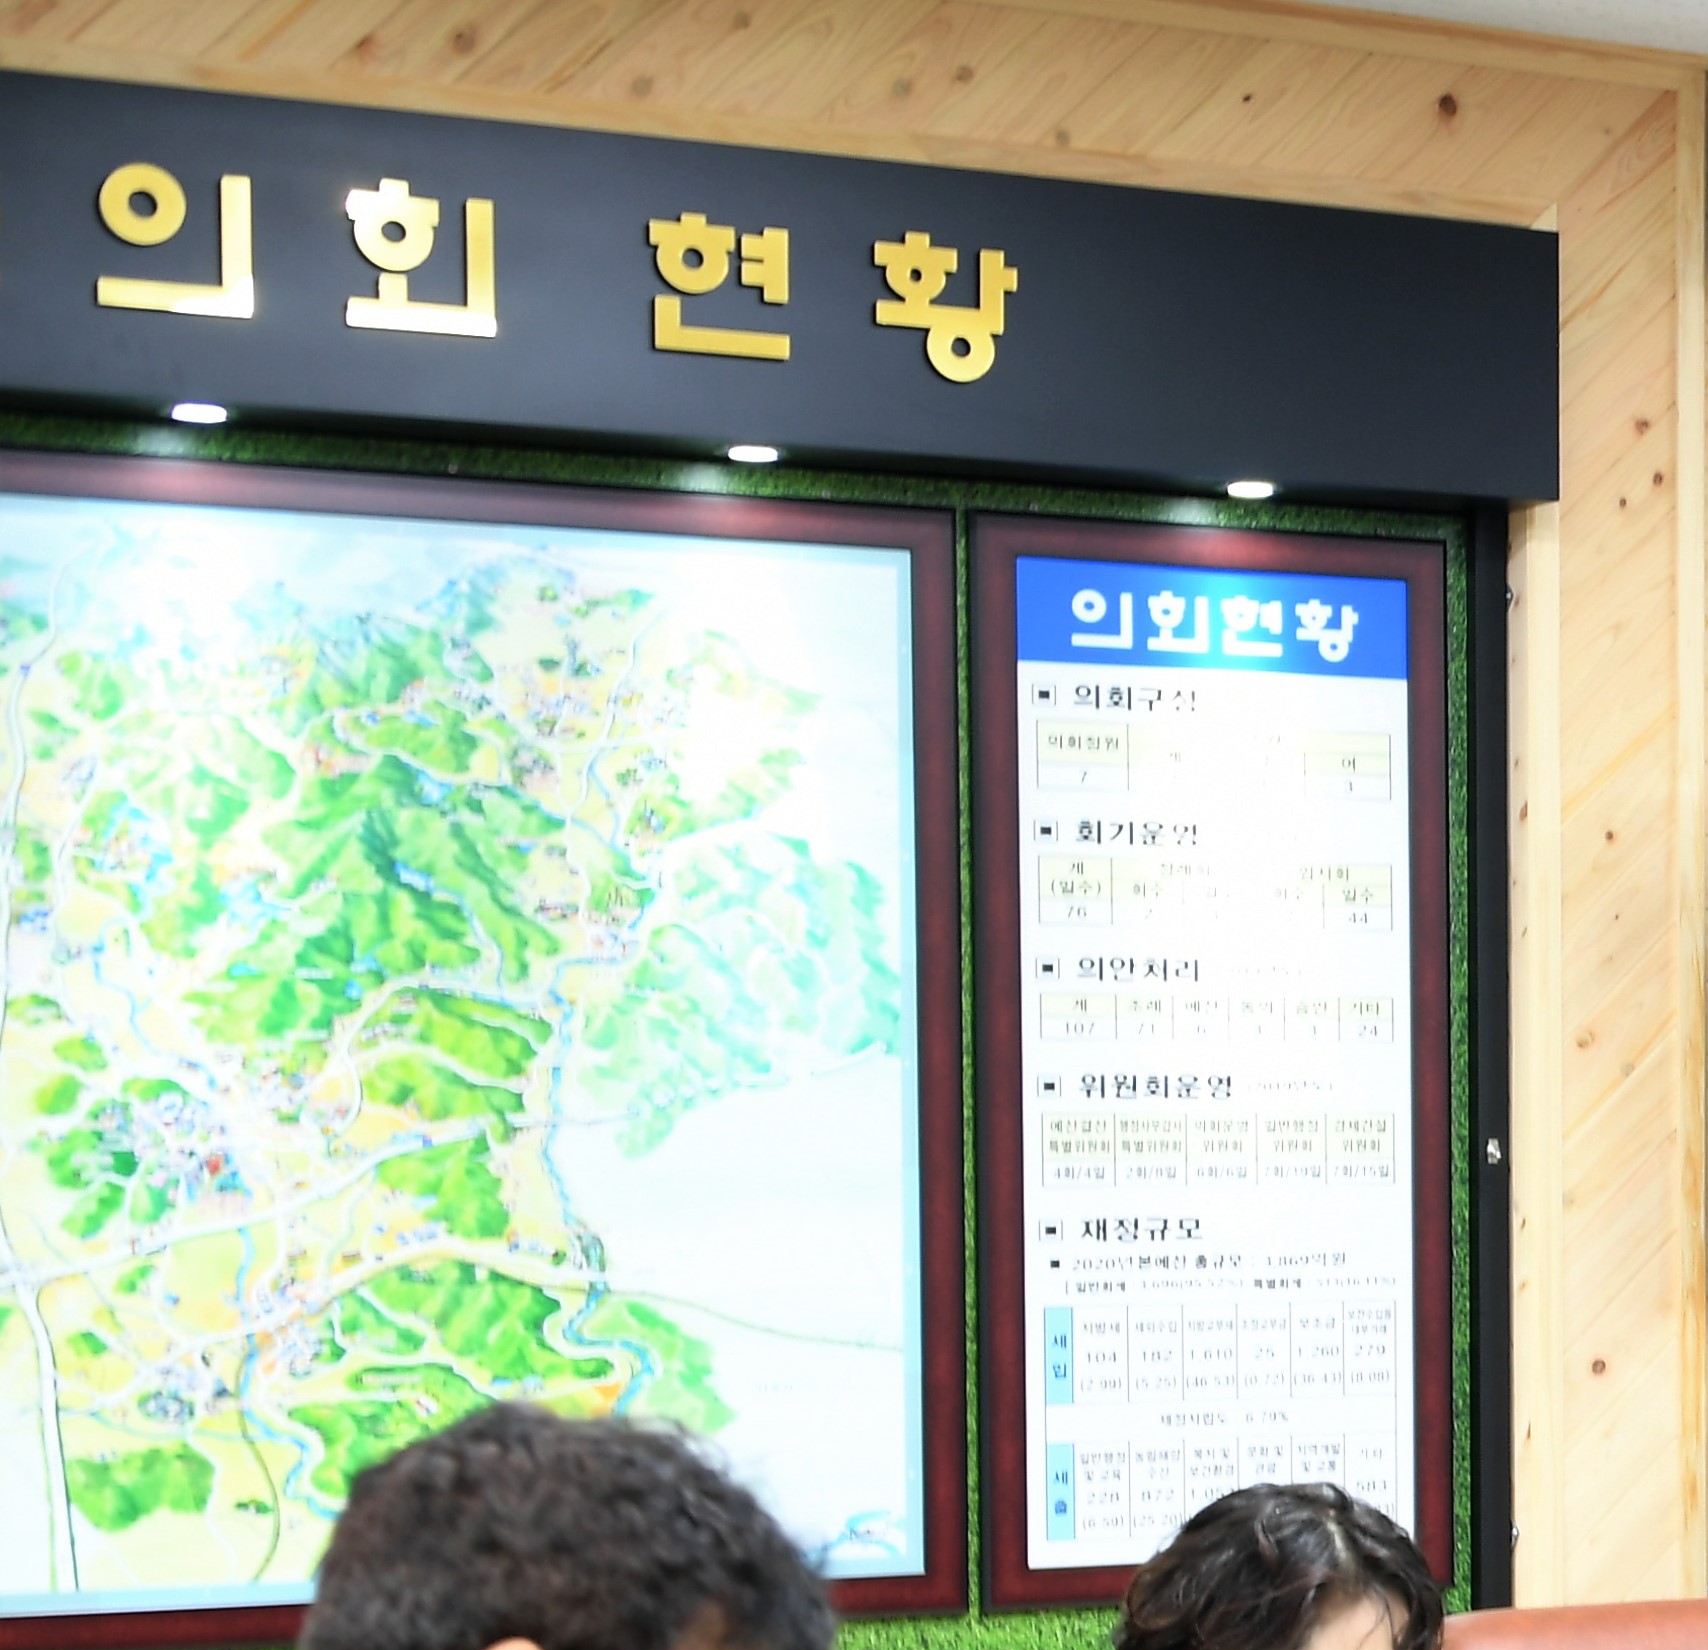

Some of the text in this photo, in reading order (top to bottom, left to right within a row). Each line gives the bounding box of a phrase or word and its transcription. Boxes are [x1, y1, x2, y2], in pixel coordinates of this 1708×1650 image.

[96, 161, 1019, 384] 의회 현황
[1071, 589, 1359, 663] 의회현황
[1075, 820, 1197, 847] 회기운영
[1076, 957, 1199, 983] 의안처리
[1079, 1073, 1232, 1100] 위원회운영
[1080, 1217, 1204, 1243] 재정규모
